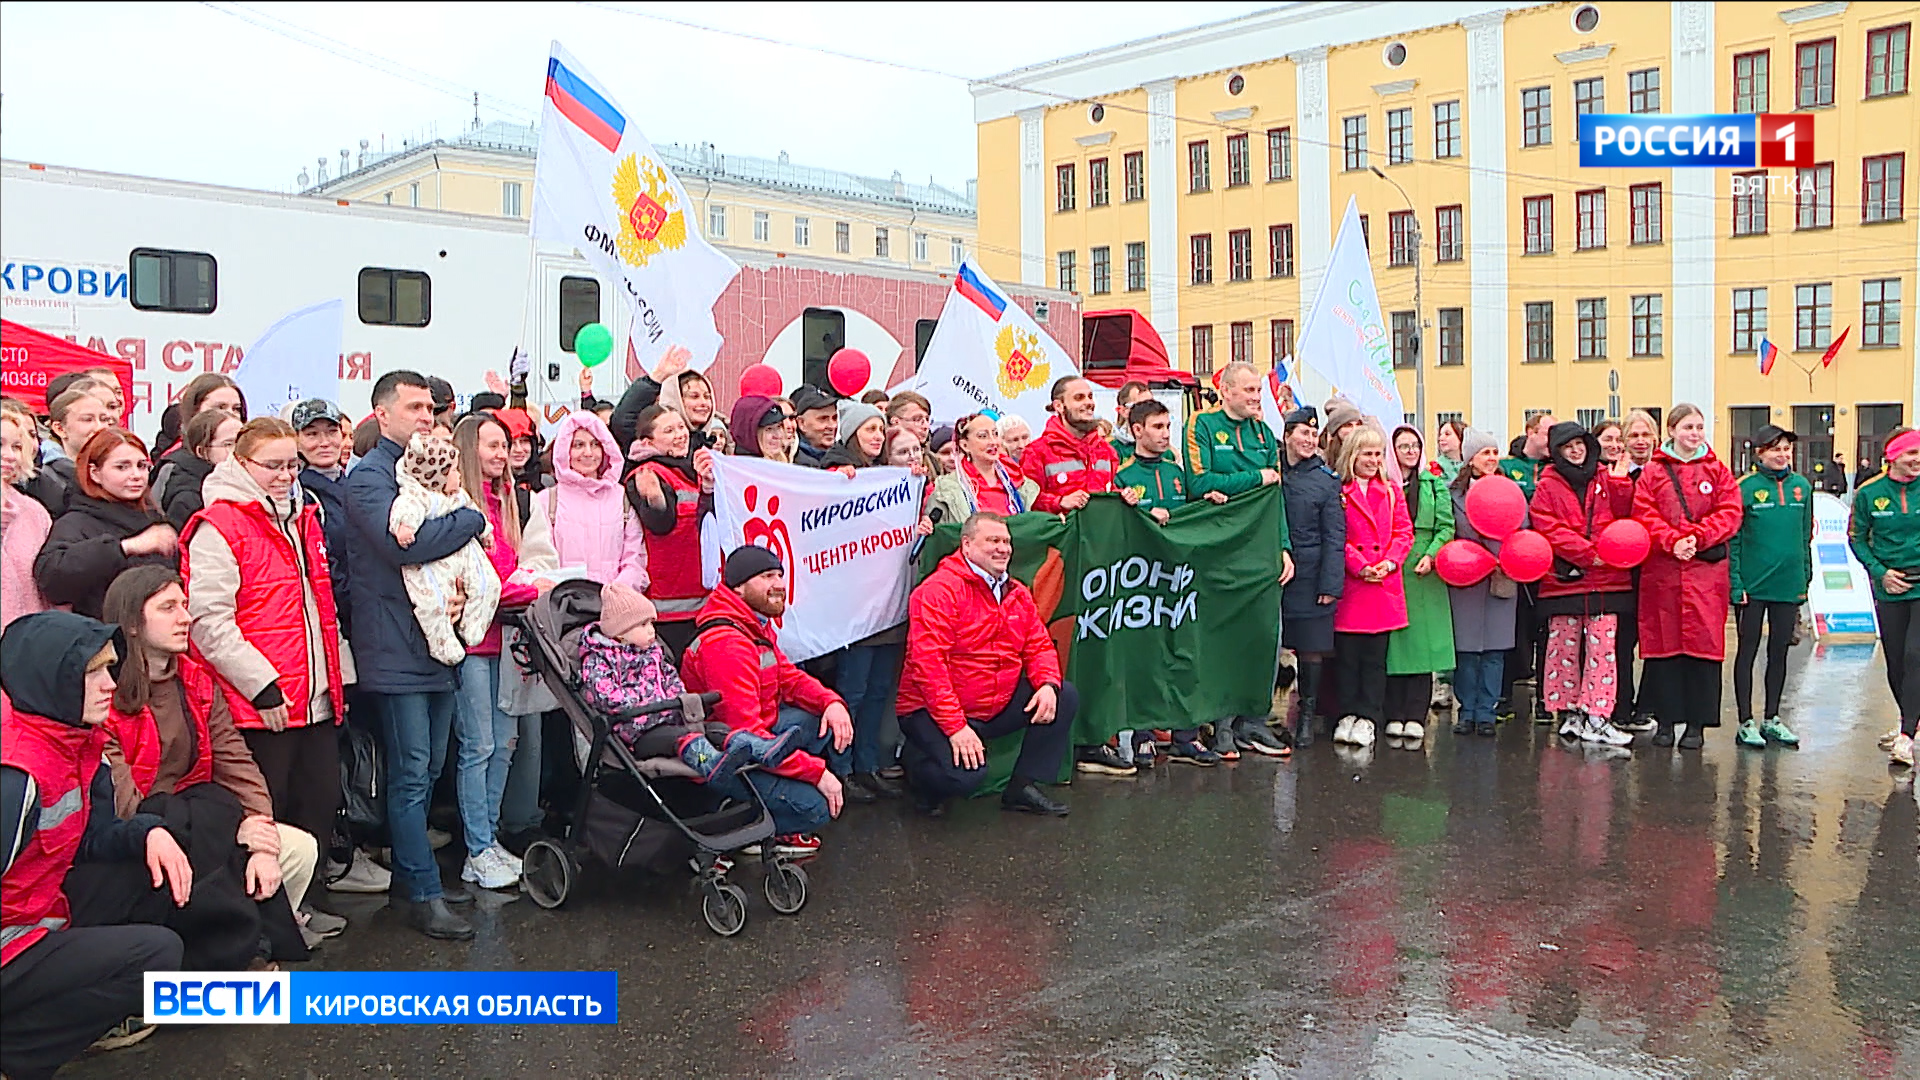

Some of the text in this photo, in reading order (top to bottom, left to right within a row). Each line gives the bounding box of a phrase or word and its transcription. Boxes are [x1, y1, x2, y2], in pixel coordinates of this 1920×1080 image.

[801, 476, 911, 533] КИРОВСКИЙ
[803, 541, 858, 575] "ЦЕНТР
[1082, 557, 1195, 602] ОГОНЬ
[1076, 591, 1200, 643] ЖИЗНИ
